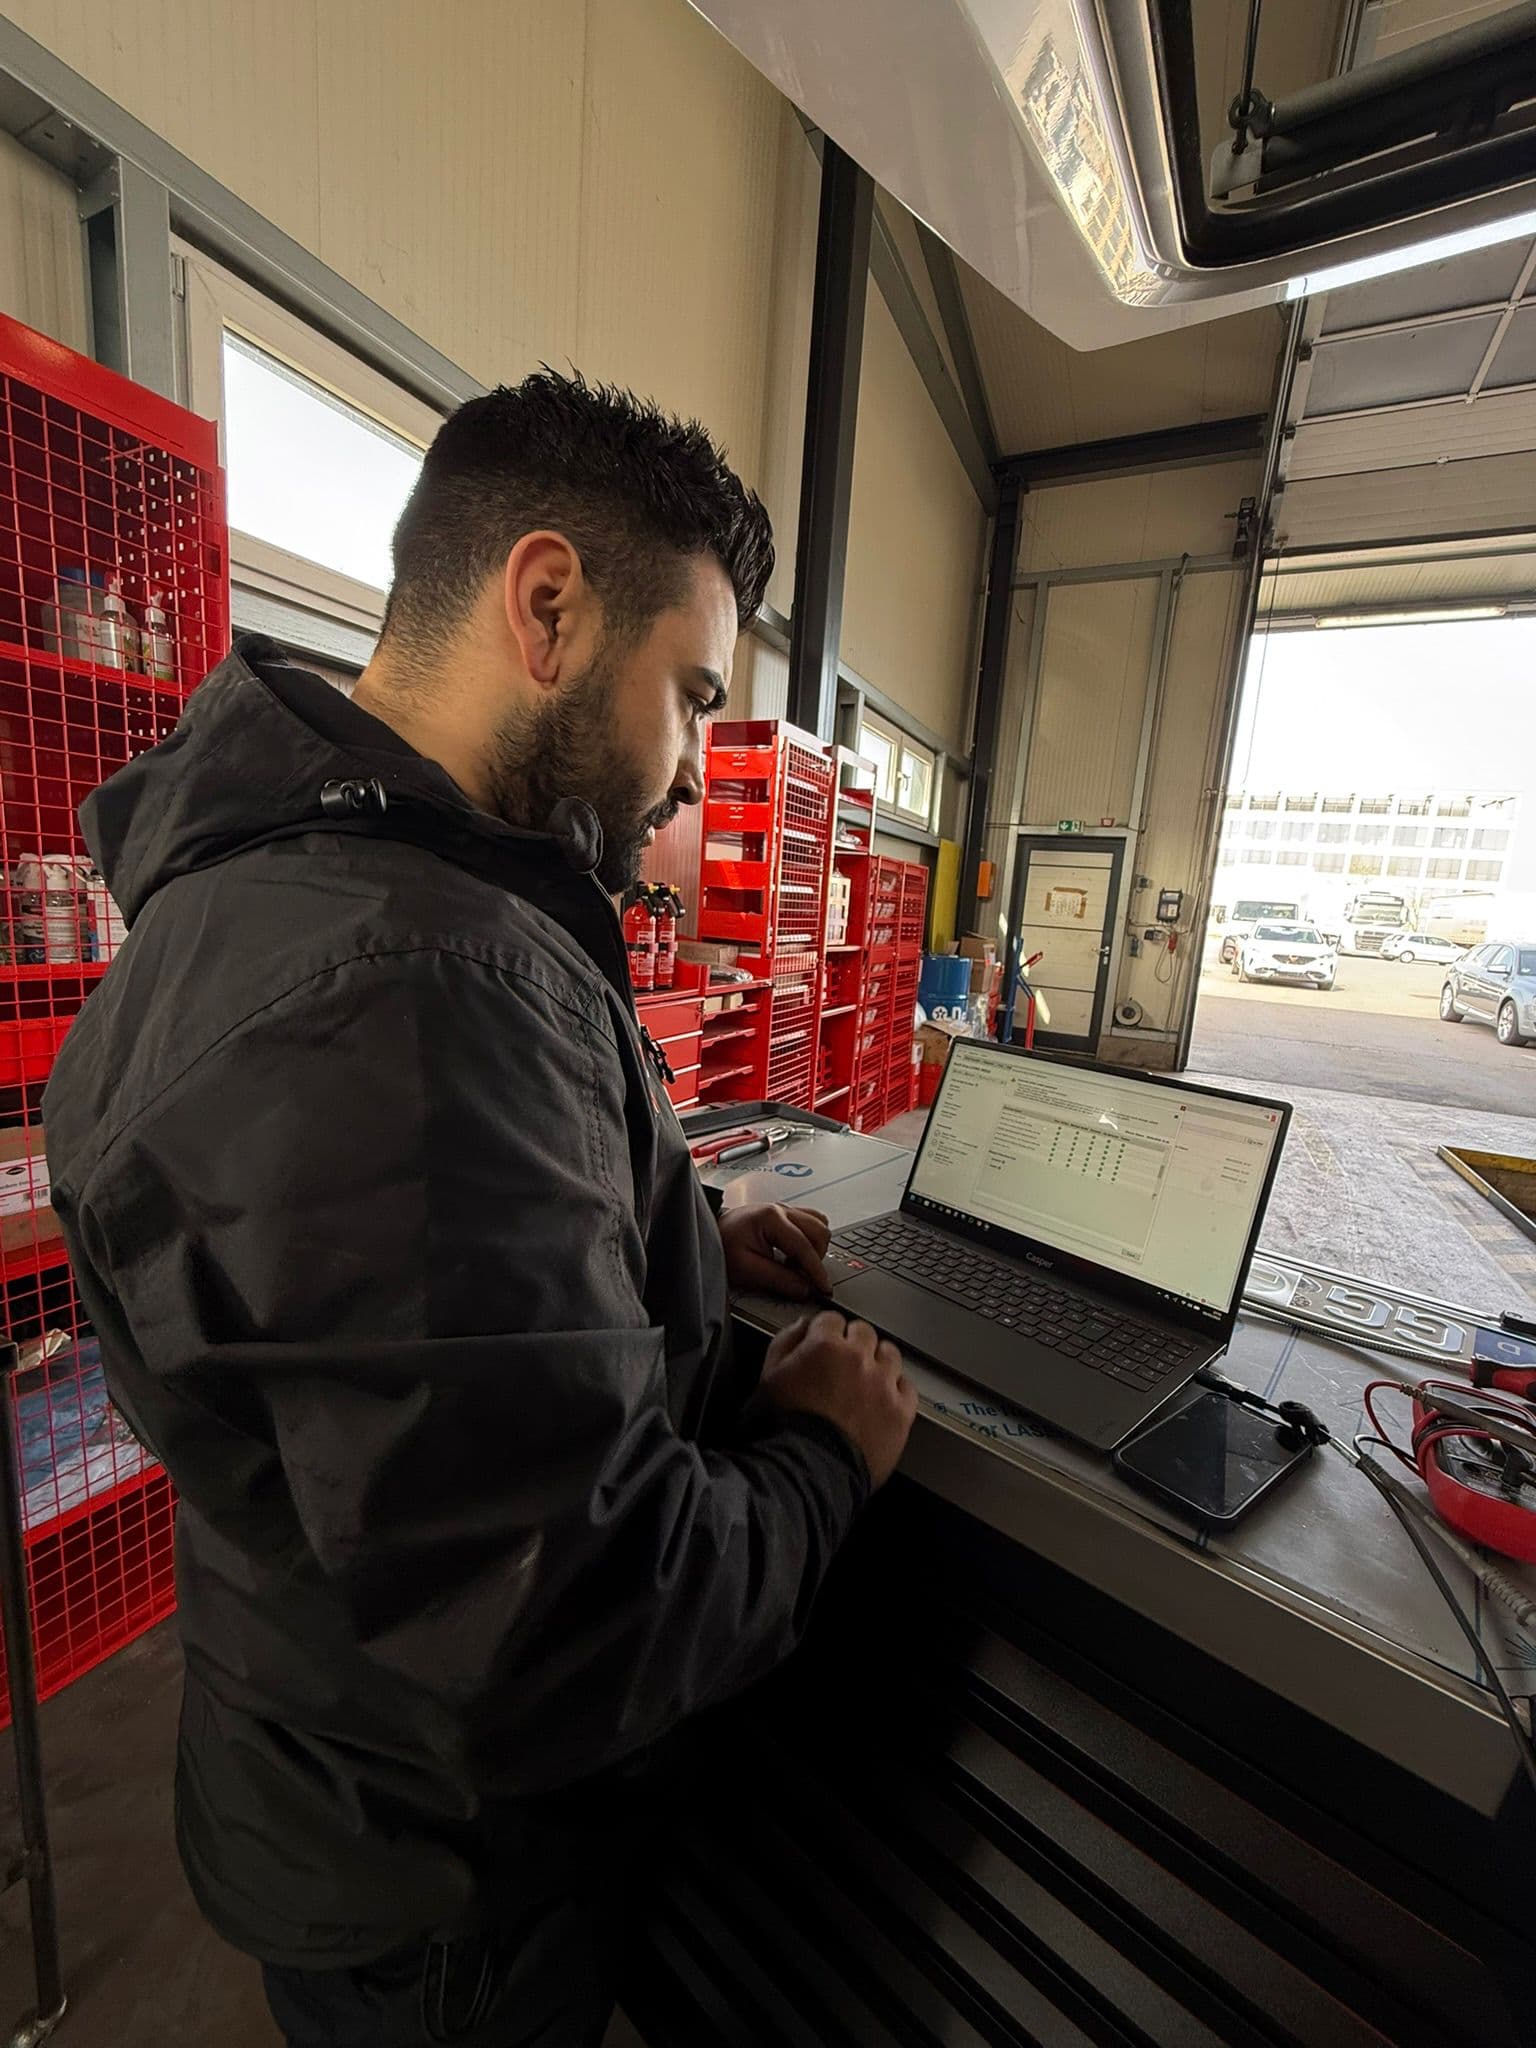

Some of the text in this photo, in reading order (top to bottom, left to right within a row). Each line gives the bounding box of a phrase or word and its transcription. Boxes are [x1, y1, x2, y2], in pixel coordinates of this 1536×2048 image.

[1026, 1252, 1054, 1269] Casper
[1497, 1341, 1521, 1355] D
[960, 1401, 998, 1417] The
